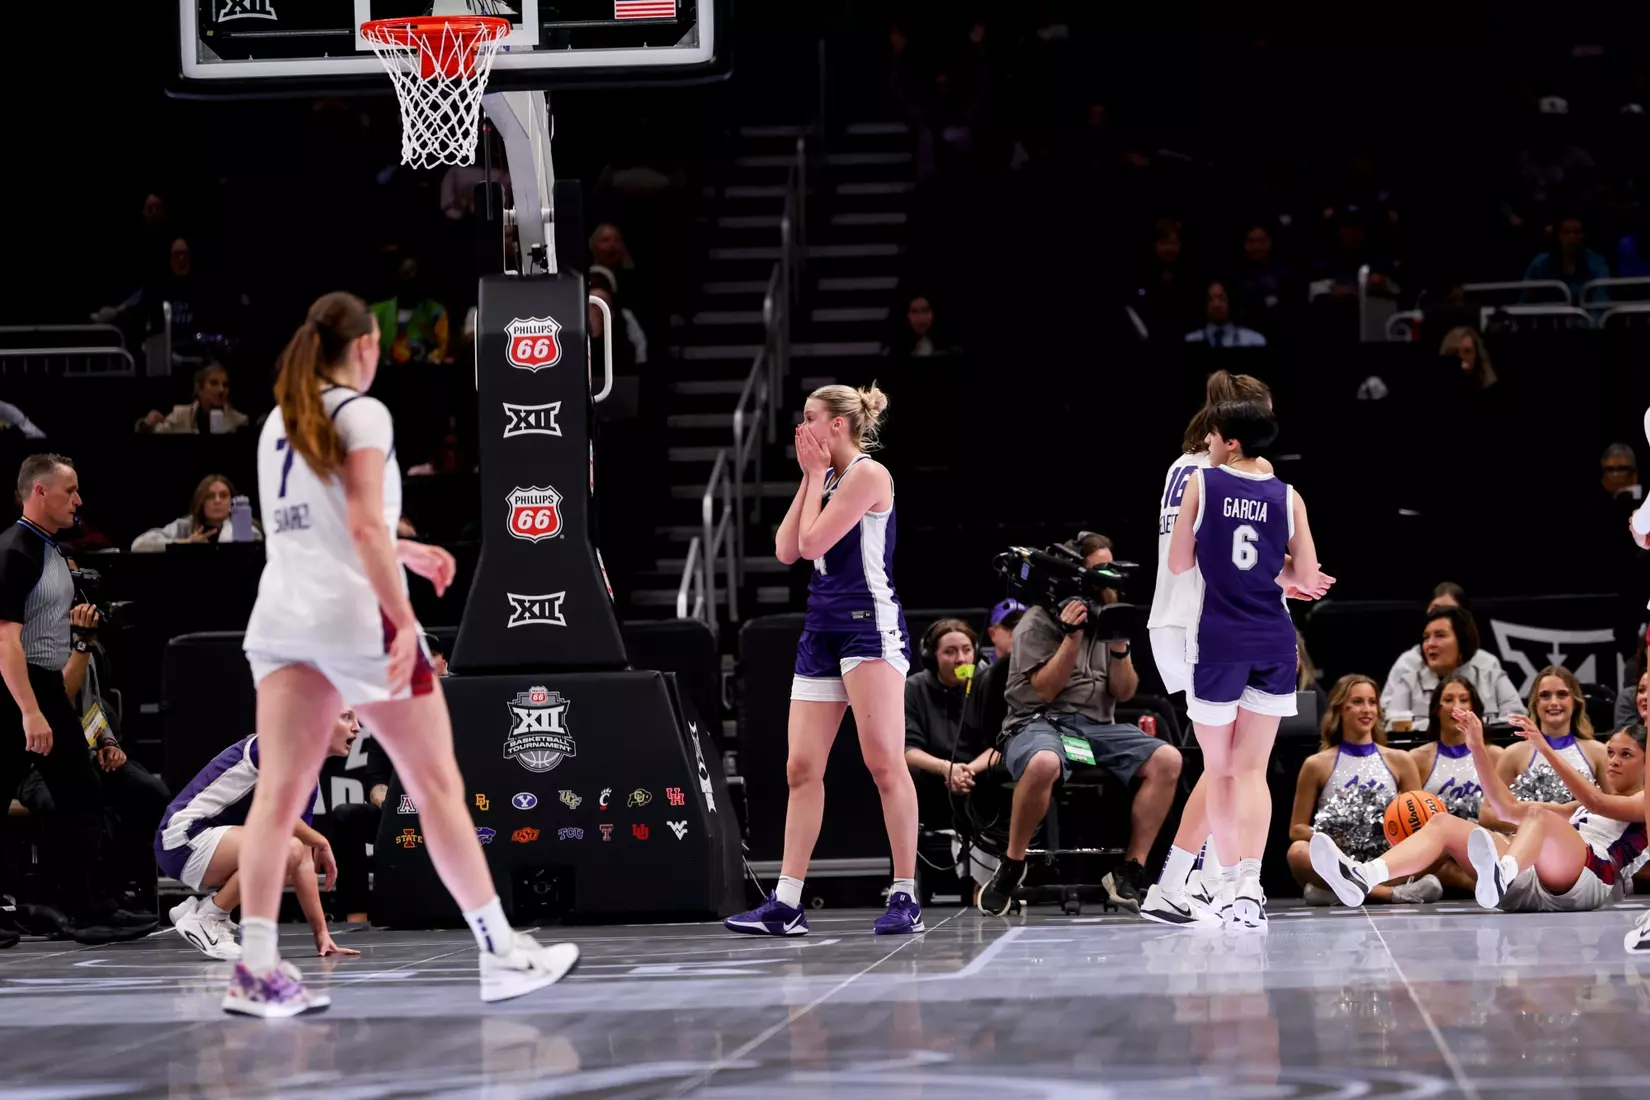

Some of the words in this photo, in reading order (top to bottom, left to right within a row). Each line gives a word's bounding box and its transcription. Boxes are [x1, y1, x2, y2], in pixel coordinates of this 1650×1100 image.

[514, 325, 553, 334] PHILLIPS
[517, 338, 550, 359] 66
[504, 402, 561, 436] XII
[276, 438, 294, 498] 7
[515, 495, 554, 505] PHILLIPS
[1223, 497, 1268, 522] GARCIA
[518, 509, 551, 530] 66
[1232, 524, 1259, 570] 6
[508, 592, 564, 626] XII
[533, 693, 545, 702] 66
[512, 705, 565, 735] XII
[508, 742, 571, 754] TOURNAMENT
[510, 736, 569, 747] BASKETBALL
[475, 793, 490, 811] BU
[558, 790, 582, 809] UCF
[558, 827, 584, 840] TCU
